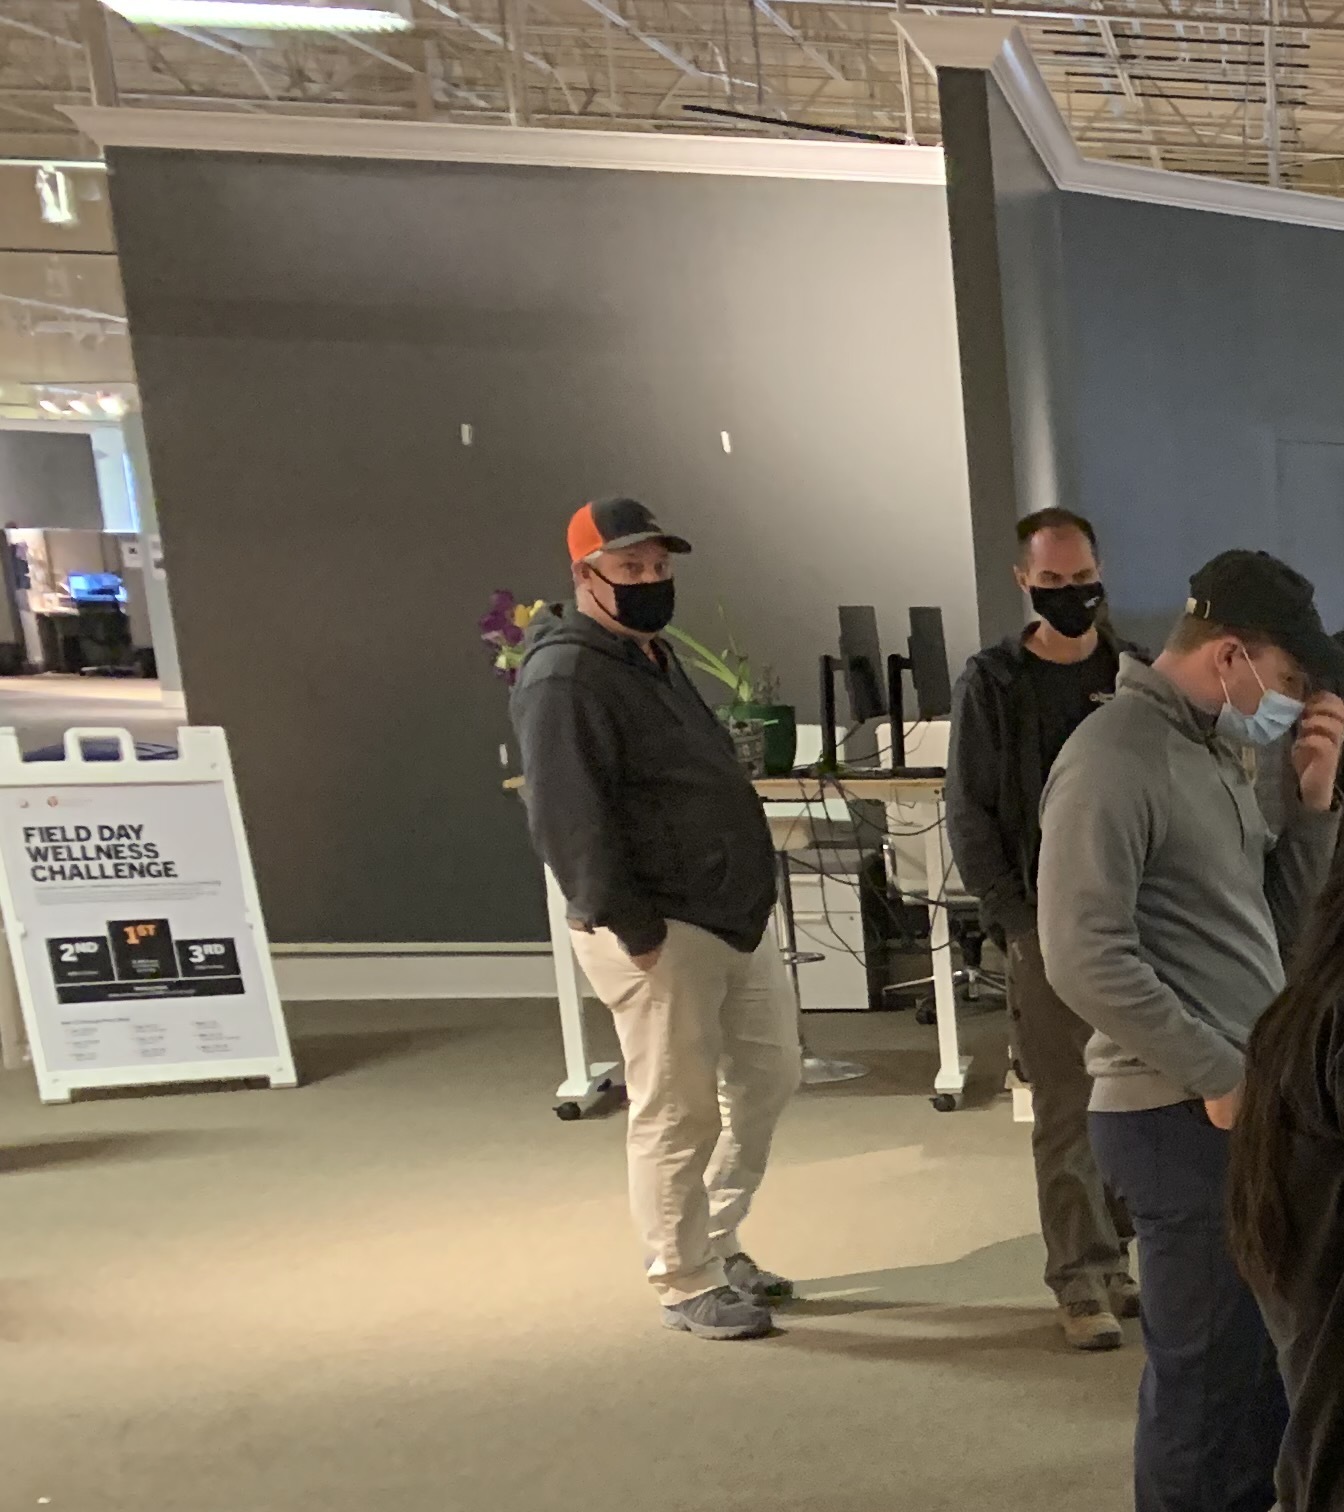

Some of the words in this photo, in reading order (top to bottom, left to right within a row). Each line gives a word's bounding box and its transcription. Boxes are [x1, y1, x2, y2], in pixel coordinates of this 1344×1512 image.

[23, 825, 92, 844] FIELD
[97, 824, 144, 842] DAY
[24, 842, 160, 863] WELLNESS
[30, 861, 178, 882] CHALLENGE
[123, 924, 156, 945] 1ST
[59, 941, 99, 963] 2ND
[188, 943, 226, 964] 3RD
